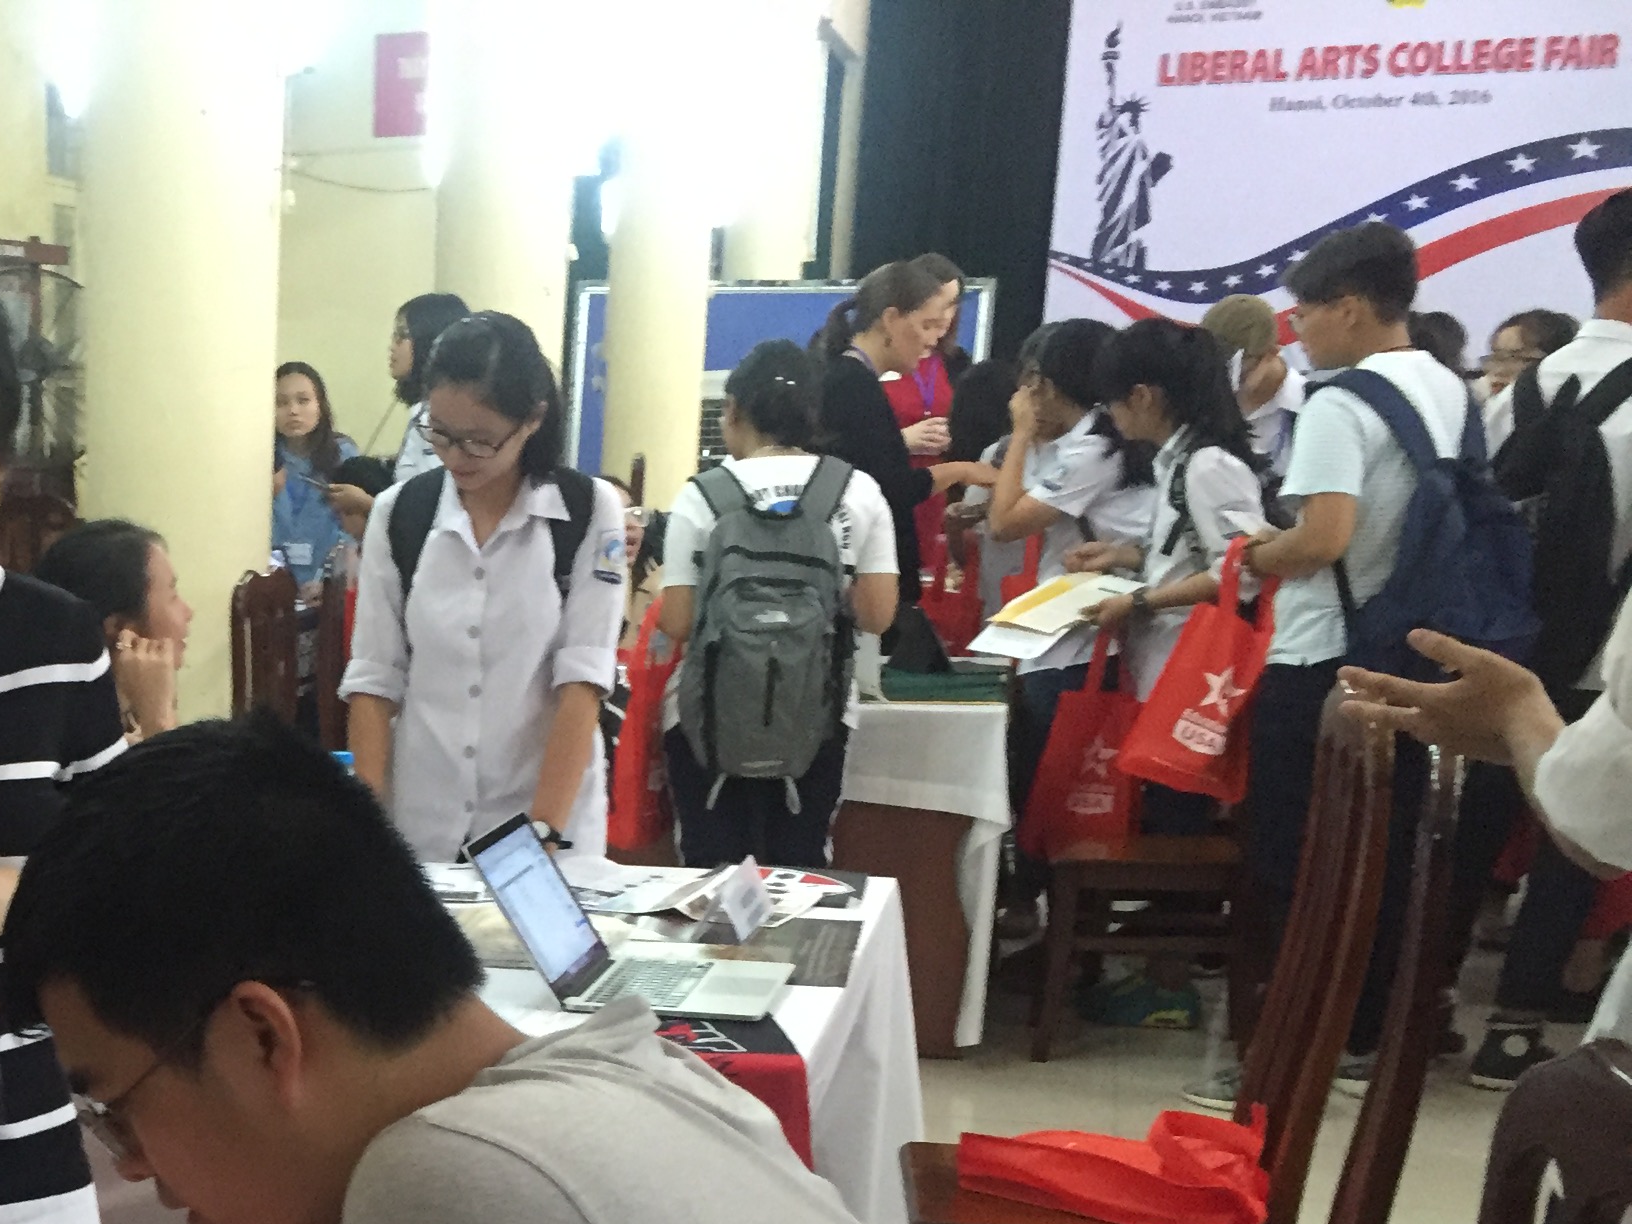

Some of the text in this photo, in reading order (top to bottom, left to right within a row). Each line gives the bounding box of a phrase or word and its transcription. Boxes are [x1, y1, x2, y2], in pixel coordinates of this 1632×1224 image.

[1157, 33, 1622, 87] LIBERAL ARTS COLLEGE FAIR
[1332, 91, 1405, 110] October
